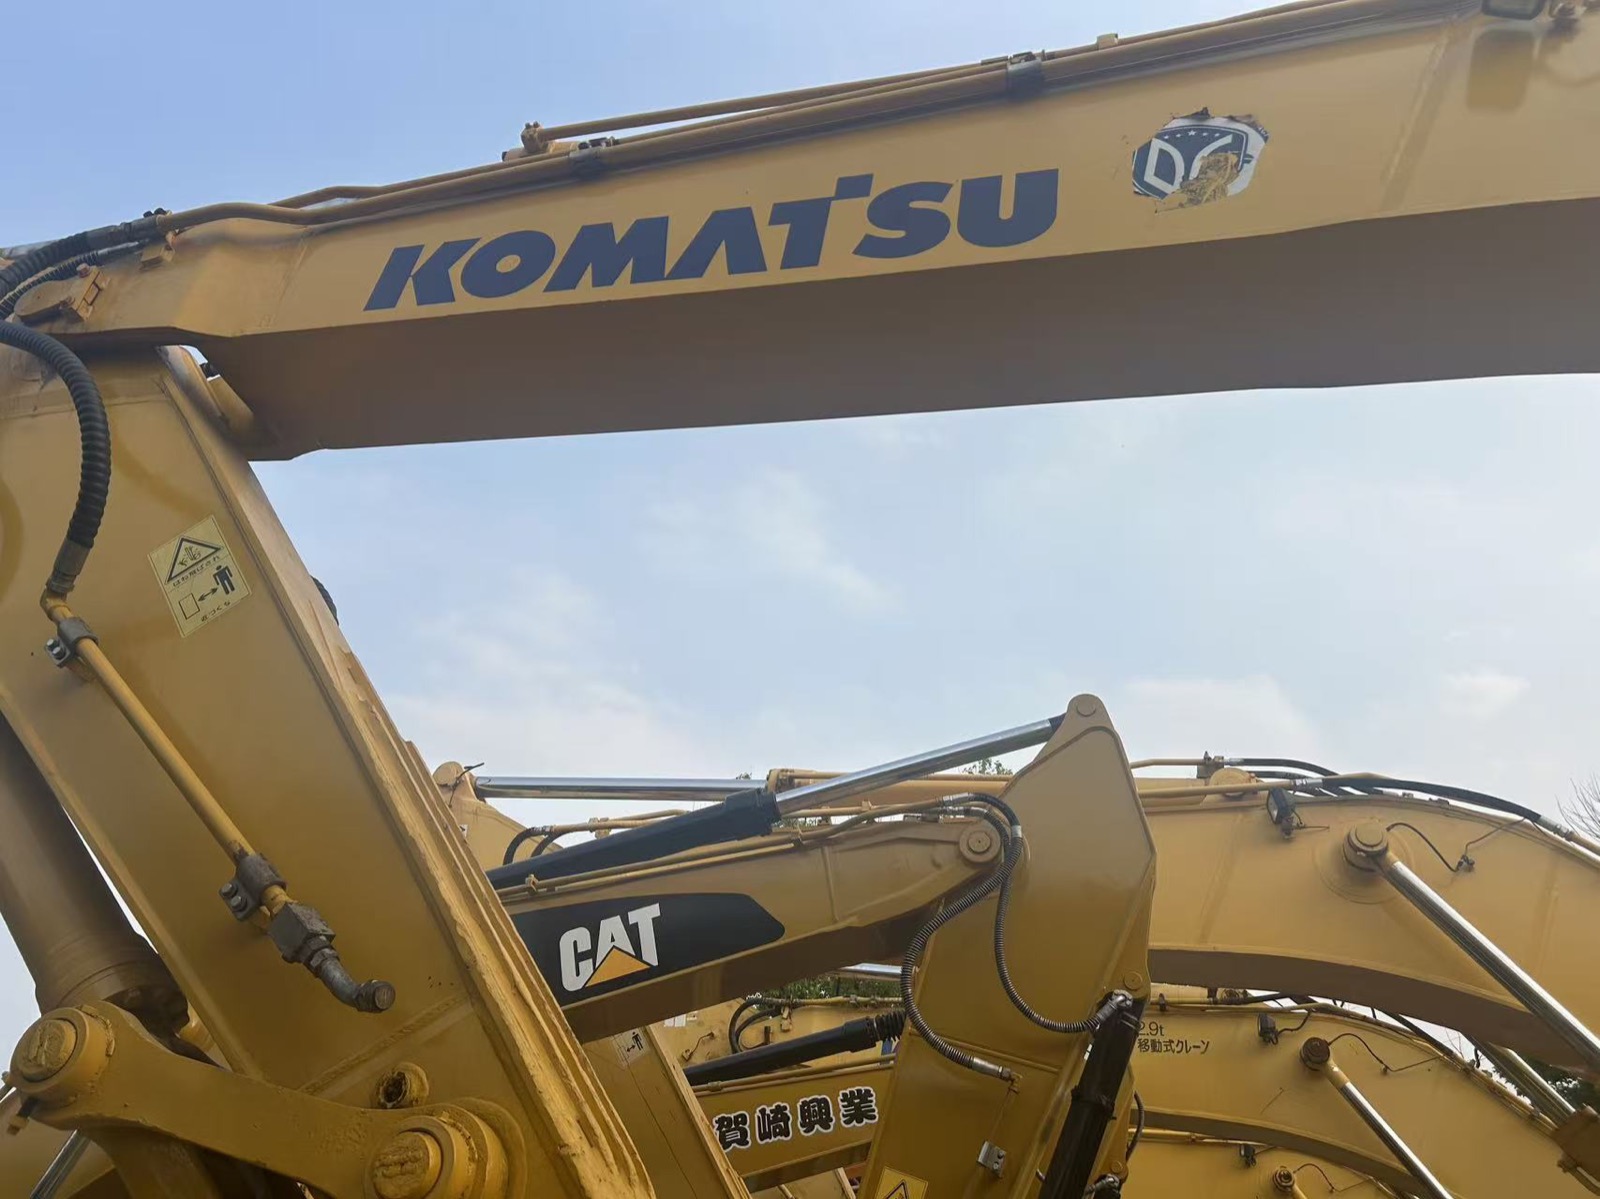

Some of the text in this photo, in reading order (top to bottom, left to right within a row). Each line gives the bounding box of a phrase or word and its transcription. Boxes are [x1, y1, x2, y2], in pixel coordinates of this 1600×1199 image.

[363, 168, 1059, 311] KOMATSU
[559, 902, 661, 992] CAT
[1138, 1038, 1210, 1055] 移動式クレーン
